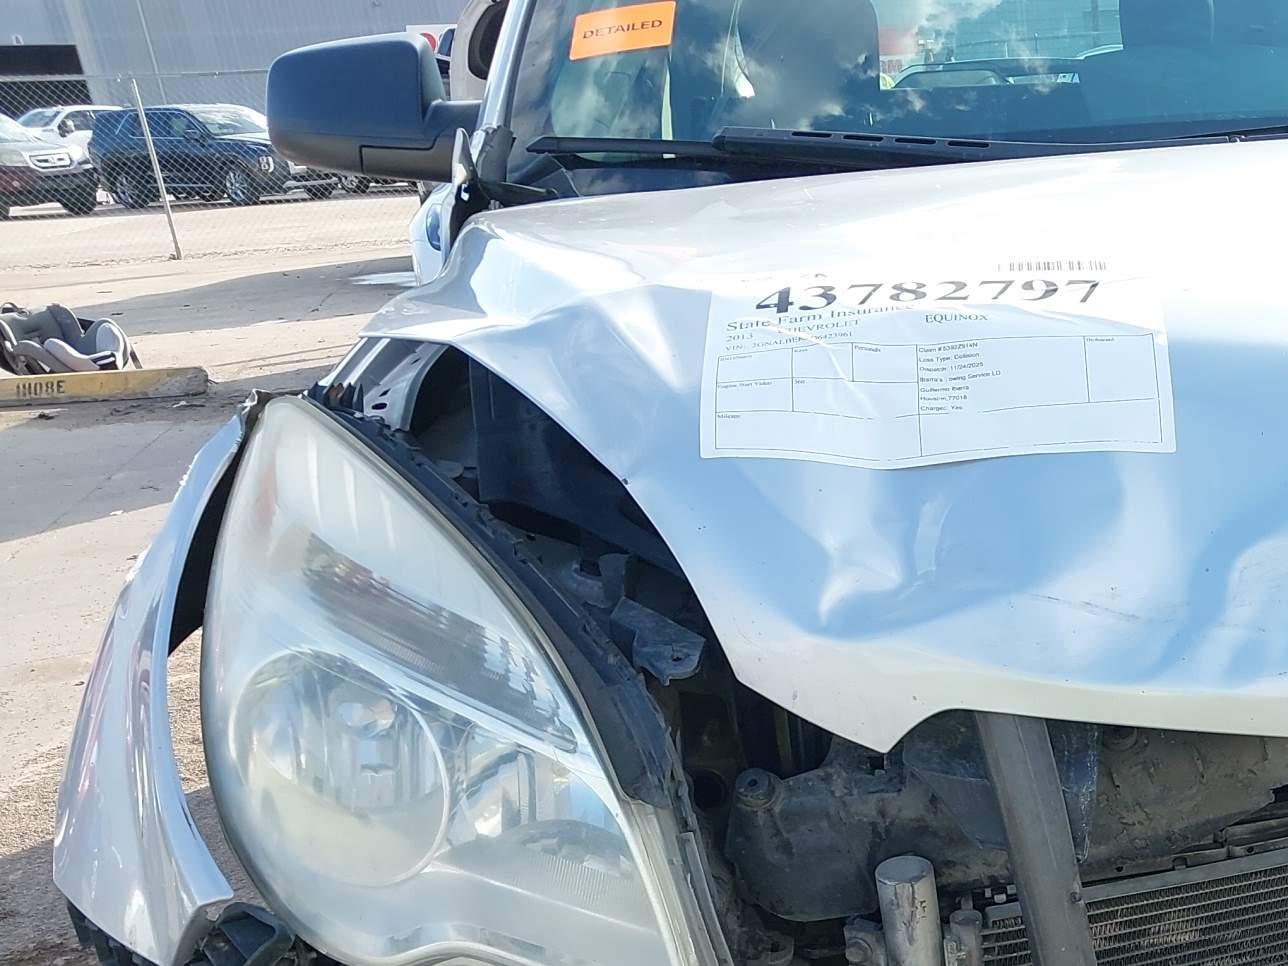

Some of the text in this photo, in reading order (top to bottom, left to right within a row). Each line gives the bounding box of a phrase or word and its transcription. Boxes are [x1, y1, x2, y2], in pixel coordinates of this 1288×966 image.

[582, 19, 663, 39] DETAILED
[755, 279, 1101, 315] 43782797
[726, 303, 914, 333] State Farm Insurance
[777, 320, 861, 335] HEVROLET
[924, 312, 990, 324] EQUINOX
